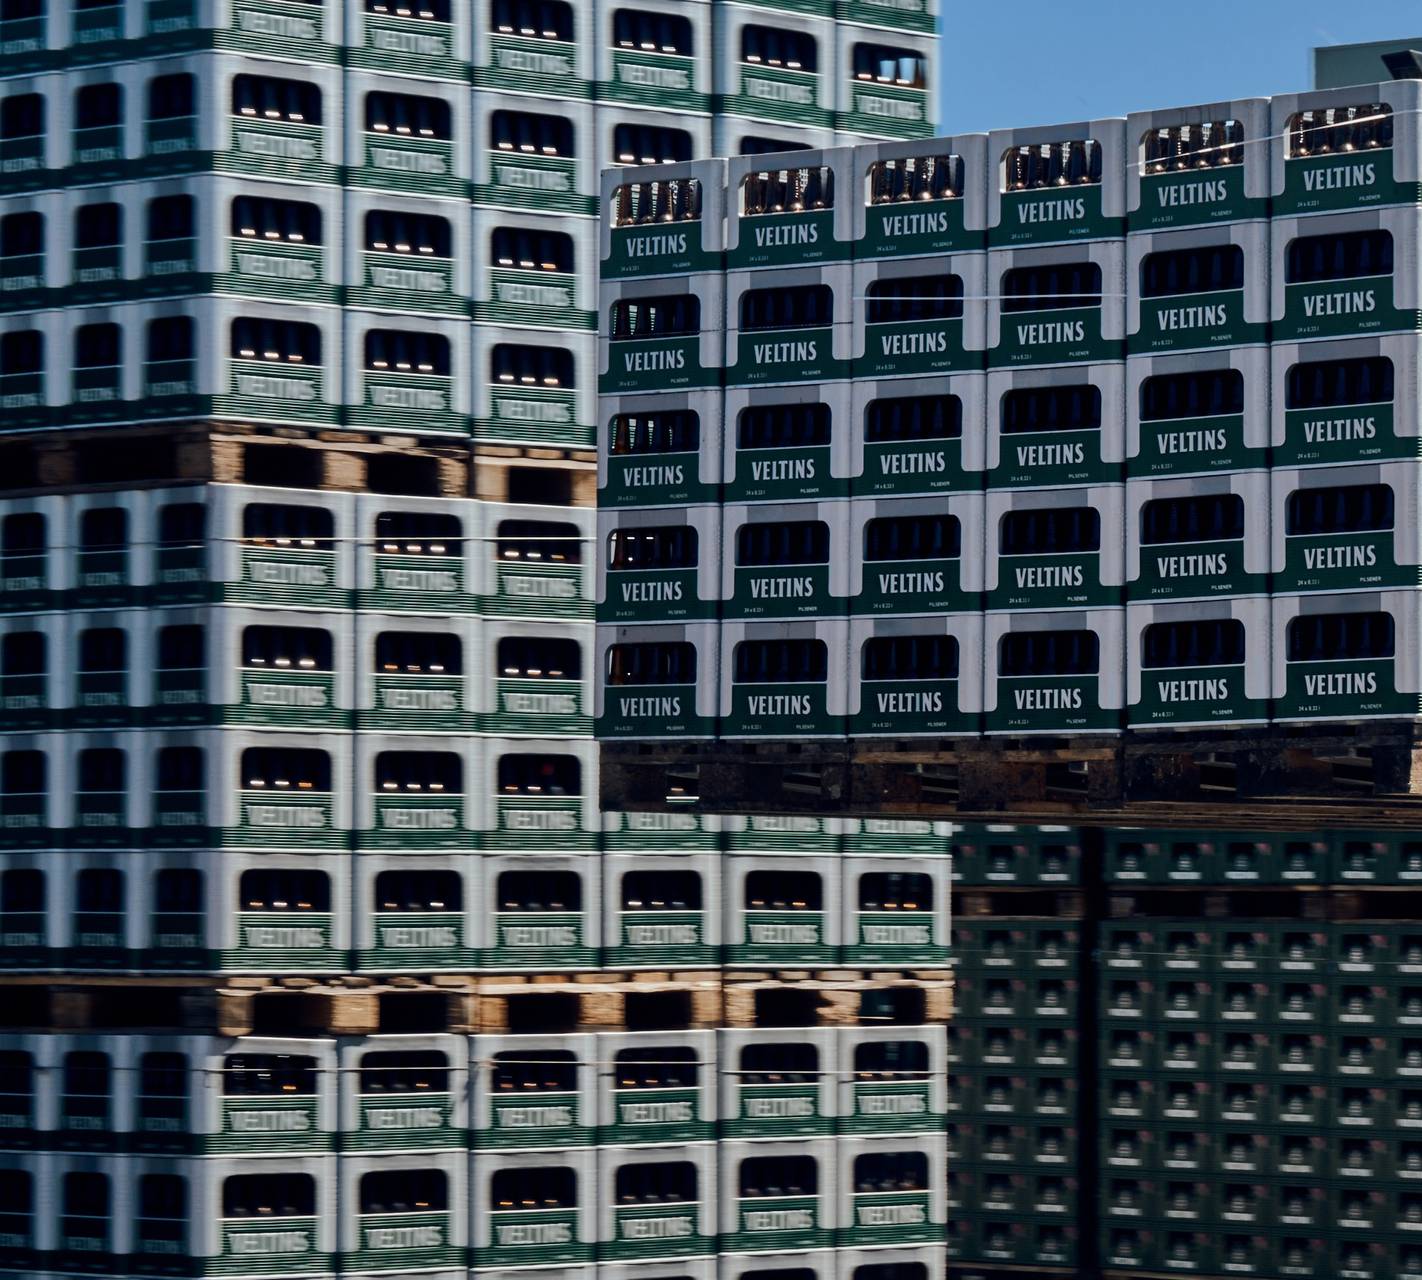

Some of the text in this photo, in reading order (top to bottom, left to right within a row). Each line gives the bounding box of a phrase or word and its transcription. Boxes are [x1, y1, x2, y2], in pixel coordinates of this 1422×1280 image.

[1304, 164, 1375, 190] VELTINS
[1159, 180, 1226, 206] VELTINS
[1019, 199, 1084, 223] VELTINS
[756, 224, 817, 246] VELTINS
[883, 212, 947, 236] VELTINS
[627, 234, 686, 257] VELTINS
[1304, 290, 1375, 316] VELTINS
[1158, 305, 1226, 330] VELTINS
[882, 332, 946, 355] VELTINS
[1018, 321, 1084, 345] VELTINS
[625, 350, 684, 371] VELTINS
[755, 341, 816, 363] VELTINS
[1158, 429, 1226, 454] VELTINS
[1304, 418, 1375, 442] VELTINS
[881, 452, 945, 474] VELTINS
[1017, 443, 1083, 466] VELTINS
[624, 466, 683, 486] VELTINS
[752, 459, 814, 480] VELTINS
[1158, 554, 1227, 577] VELTINS
[1304, 545, 1376, 569] VELTINS
[751, 577, 813, 598] VELTINS
[880, 572, 943, 593] VELTINS
[1016, 566, 1083, 588] VELTINS
[622, 581, 682, 601] VELTINS
[1159, 679, 1227, 702] VELTINS
[1305, 672, 1376, 695] VELTINS
[621, 697, 680, 716] VELTINS
[749, 695, 810, 715] VELTINS
[878, 692, 942, 712] VELTINS
[1015, 689, 1081, 709] VELTINS
